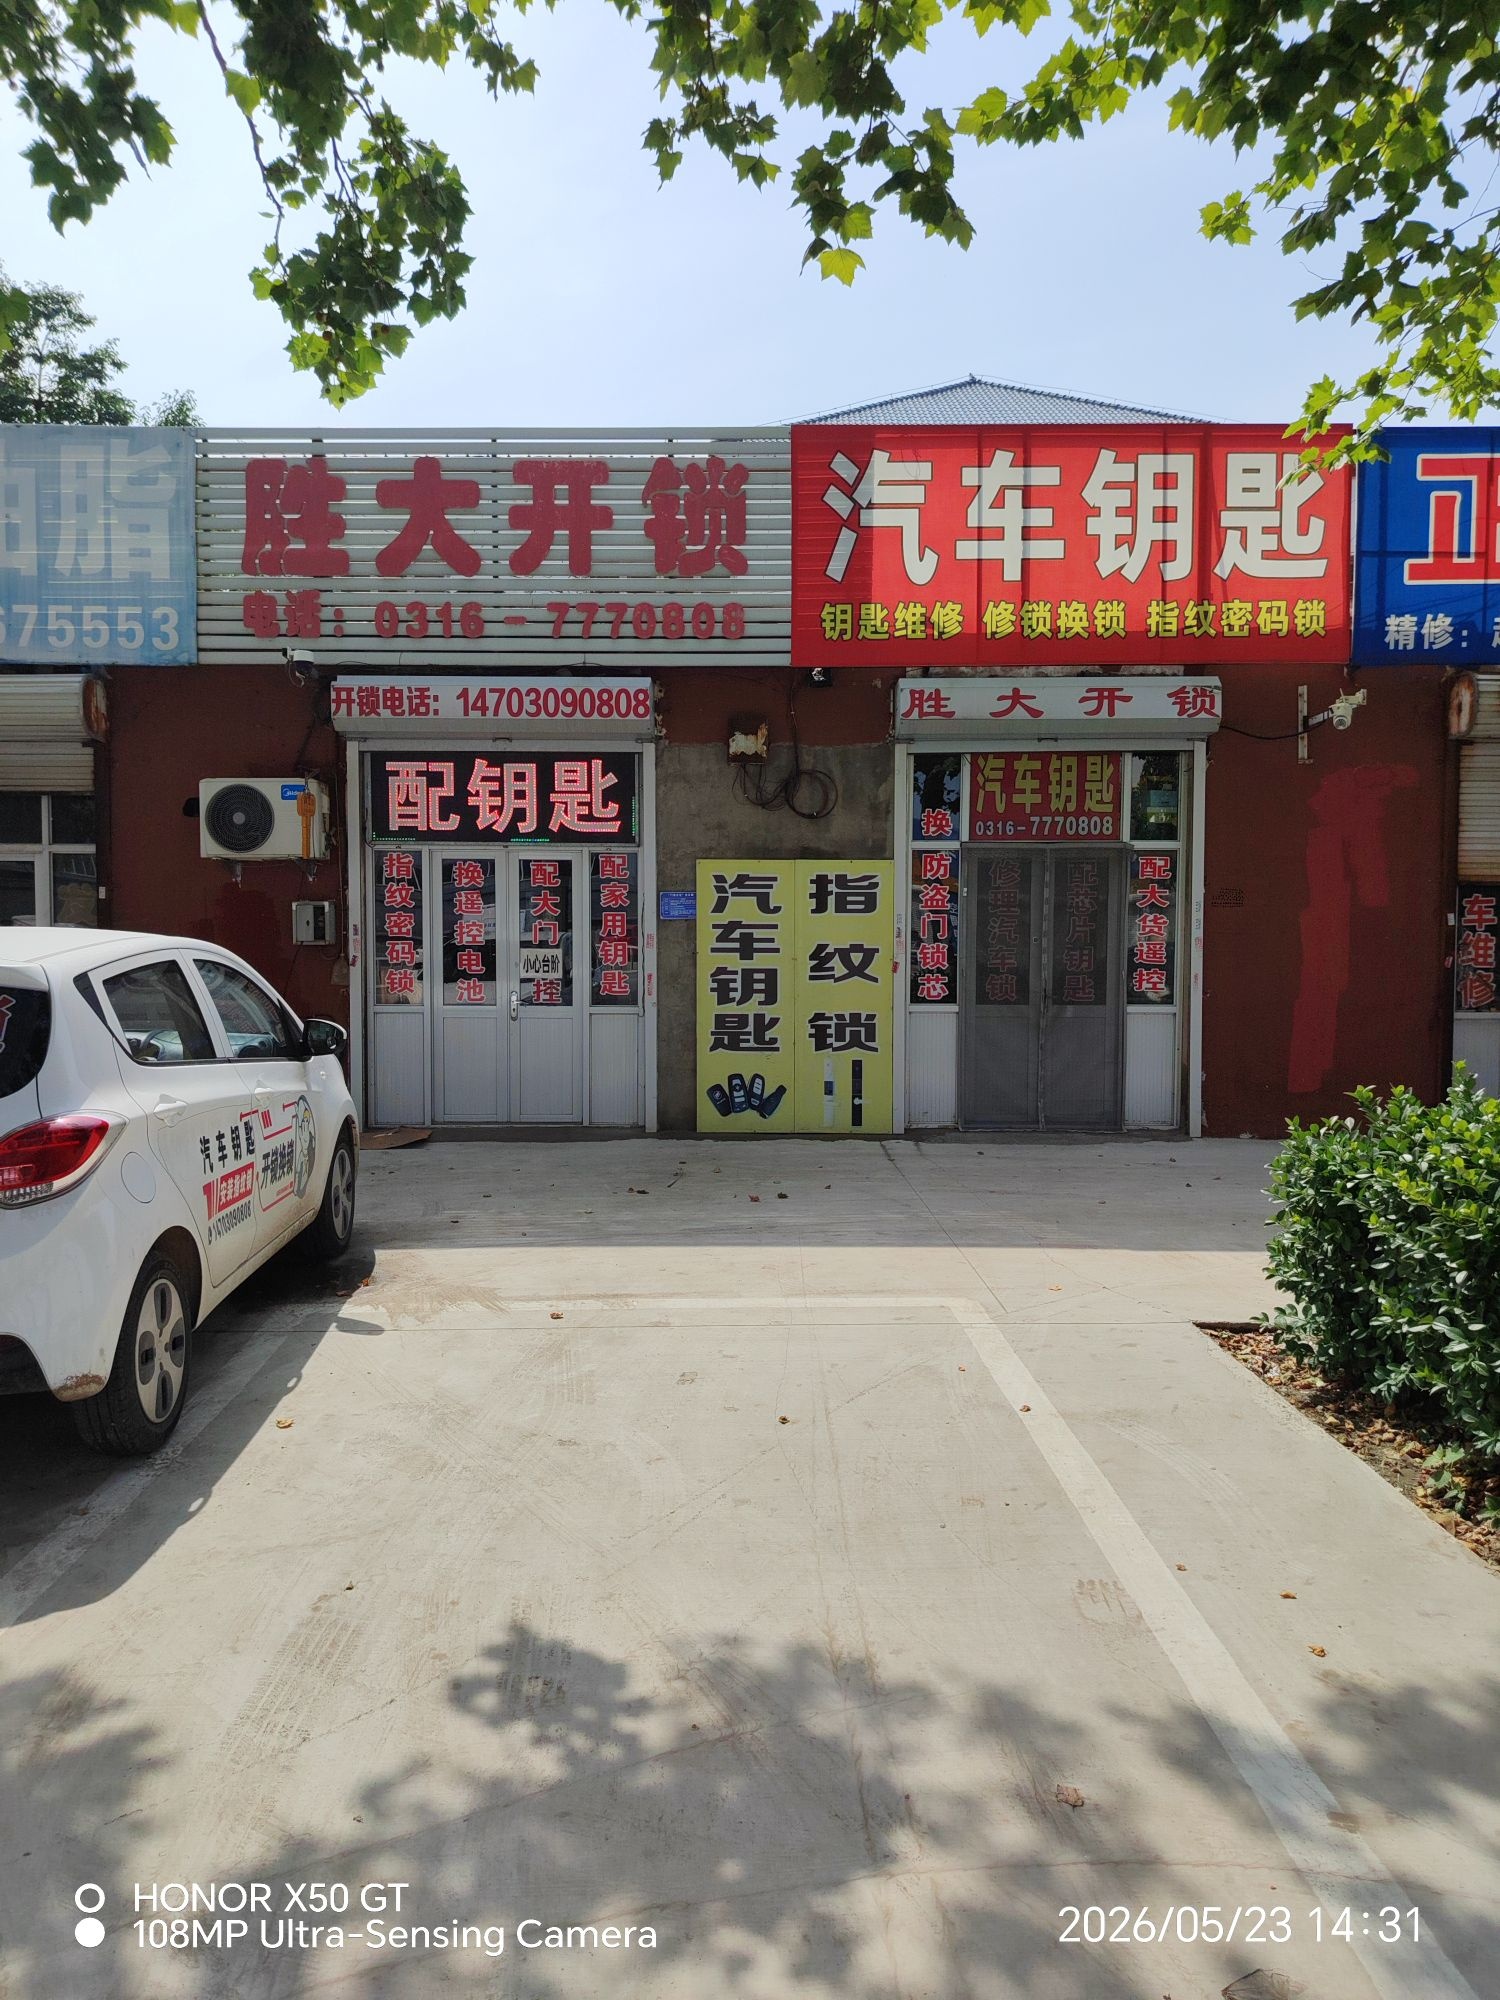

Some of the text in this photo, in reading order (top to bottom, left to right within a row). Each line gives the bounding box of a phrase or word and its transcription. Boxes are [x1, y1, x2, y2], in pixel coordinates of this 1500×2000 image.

[241, 455, 749, 577] 胜大开锁
[822, 449, 1328, 585] 汽车钥匙
[0, 604, 179, 651] 75553
[821, 598, 1327, 641] 钥匙维修 修锁换锁 指纹密码锁
[456, 687, 650, 718] 14703090808
[901, 685, 1219, 718] 胜大开锁
[385, 758, 622, 833] 配钥匙
[975, 754, 1114, 814] 汽车钥匙
[976, 816, 1113, 836] 0316-7770808
[384, 852, 416, 994] 指纹密码锁
[454, 861, 486, 1003] 换遥控电池
[523, 954, 560, 974] 小心台阶
[530, 861, 562, 1004] 配大门控
[598, 854, 630, 996] 配家用钥匙
[709, 874, 782, 1052] 汽车钥匙
[808, 874, 880, 1053] 指纹锁
[985, 860, 1022, 1002] 修理汽车锁
[1133, 856, 1172, 993] 配大货遥控
[1457, 893, 1498, 1009] 车维修
[199, 1119, 256, 1175] 汽车钥匙
